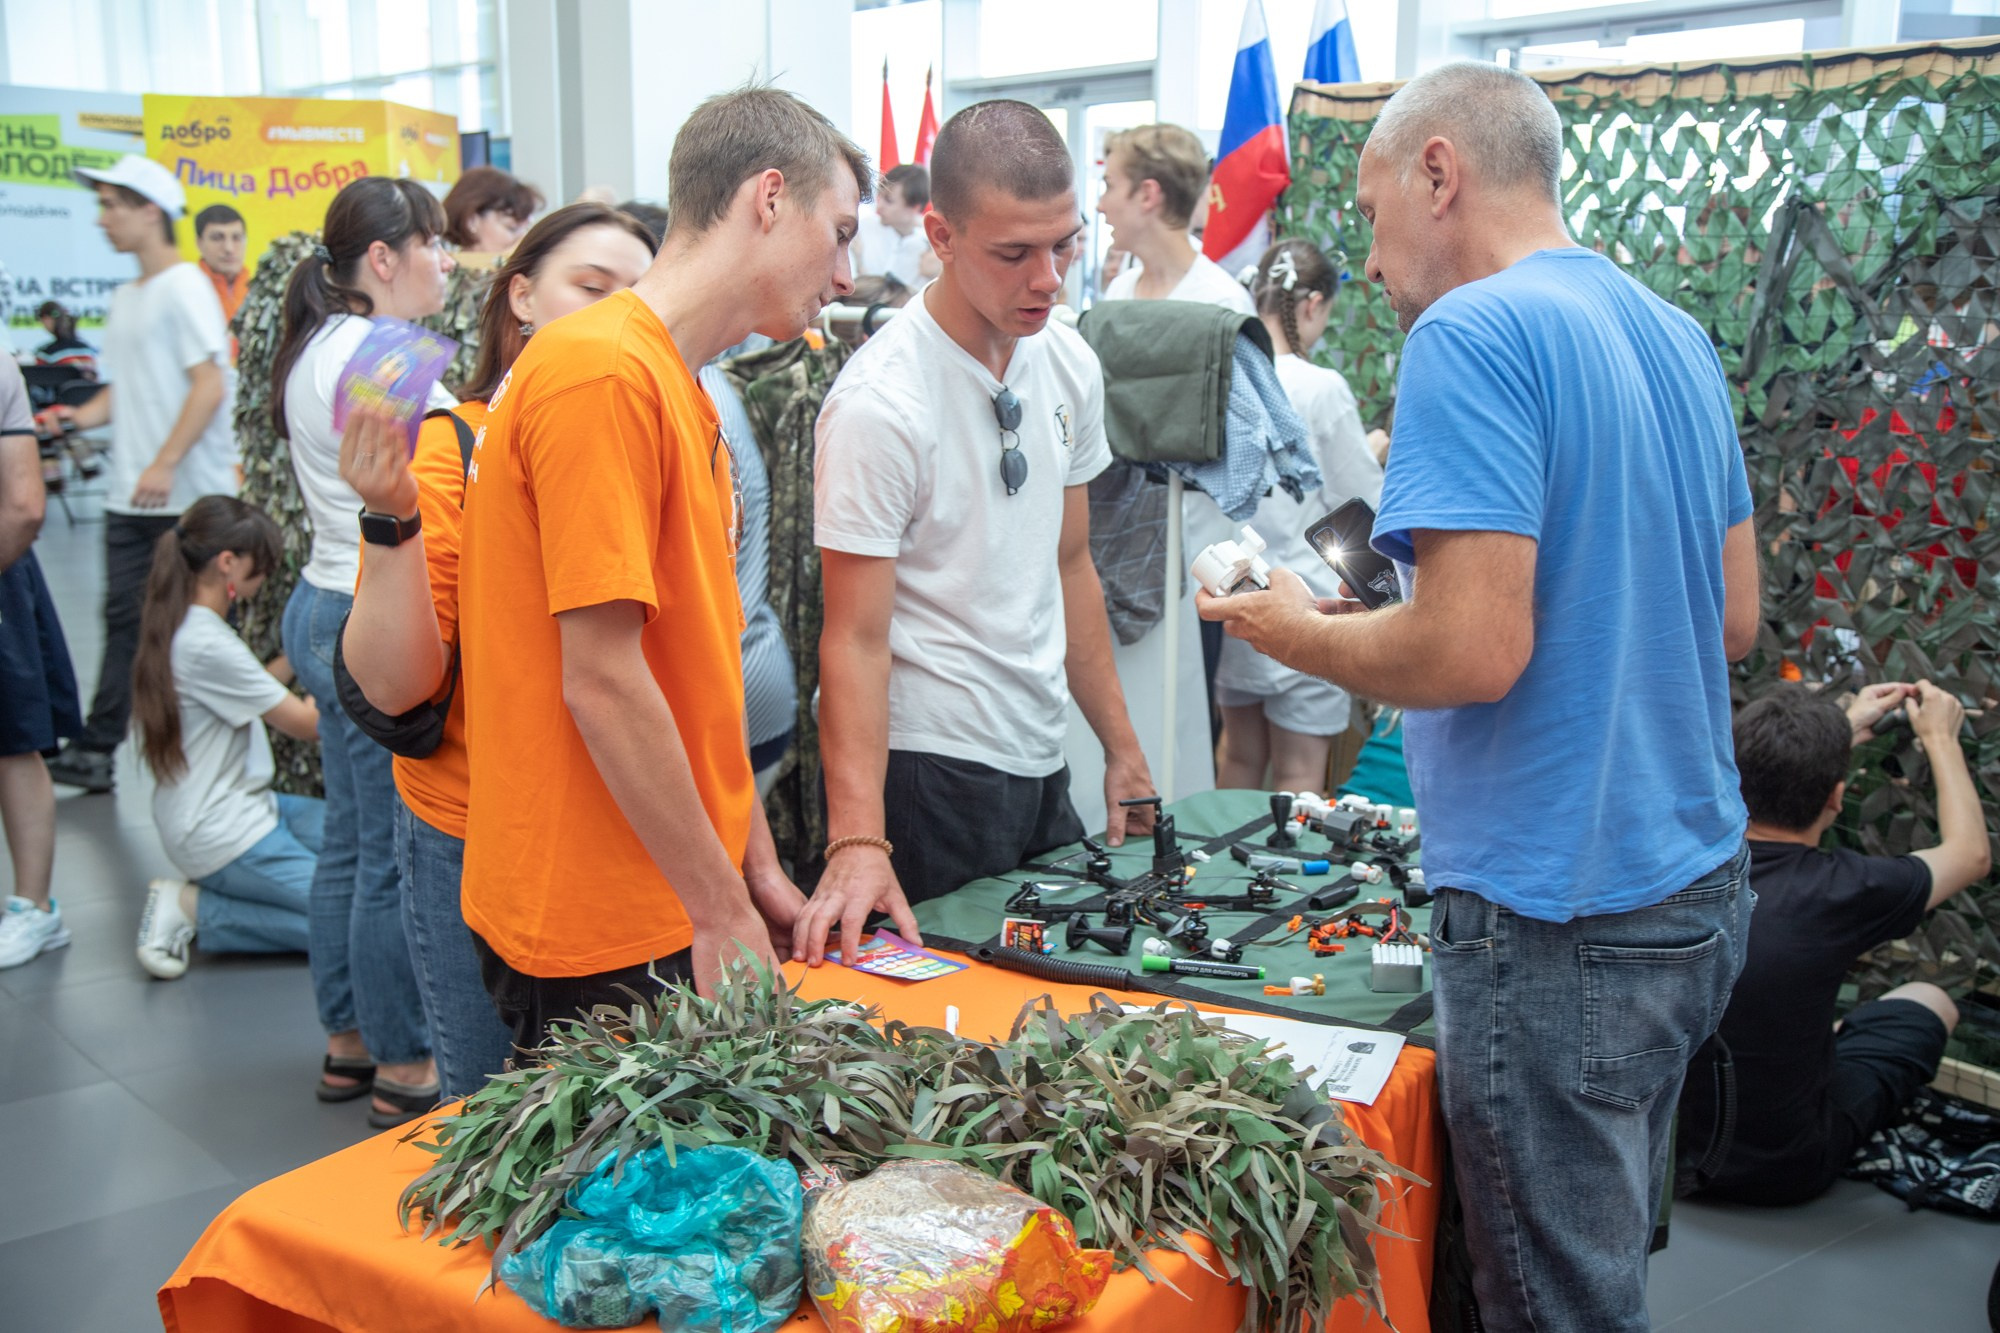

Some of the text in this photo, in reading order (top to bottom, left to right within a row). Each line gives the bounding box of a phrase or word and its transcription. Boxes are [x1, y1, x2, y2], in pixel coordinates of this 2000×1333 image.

[161, 120, 231, 144] добро
[267, 126, 365, 142] #МЫВМЕСТЕ
[268, 160, 369, 199] Добра
[1174, 965, 1199, 973] МАРКЕР
